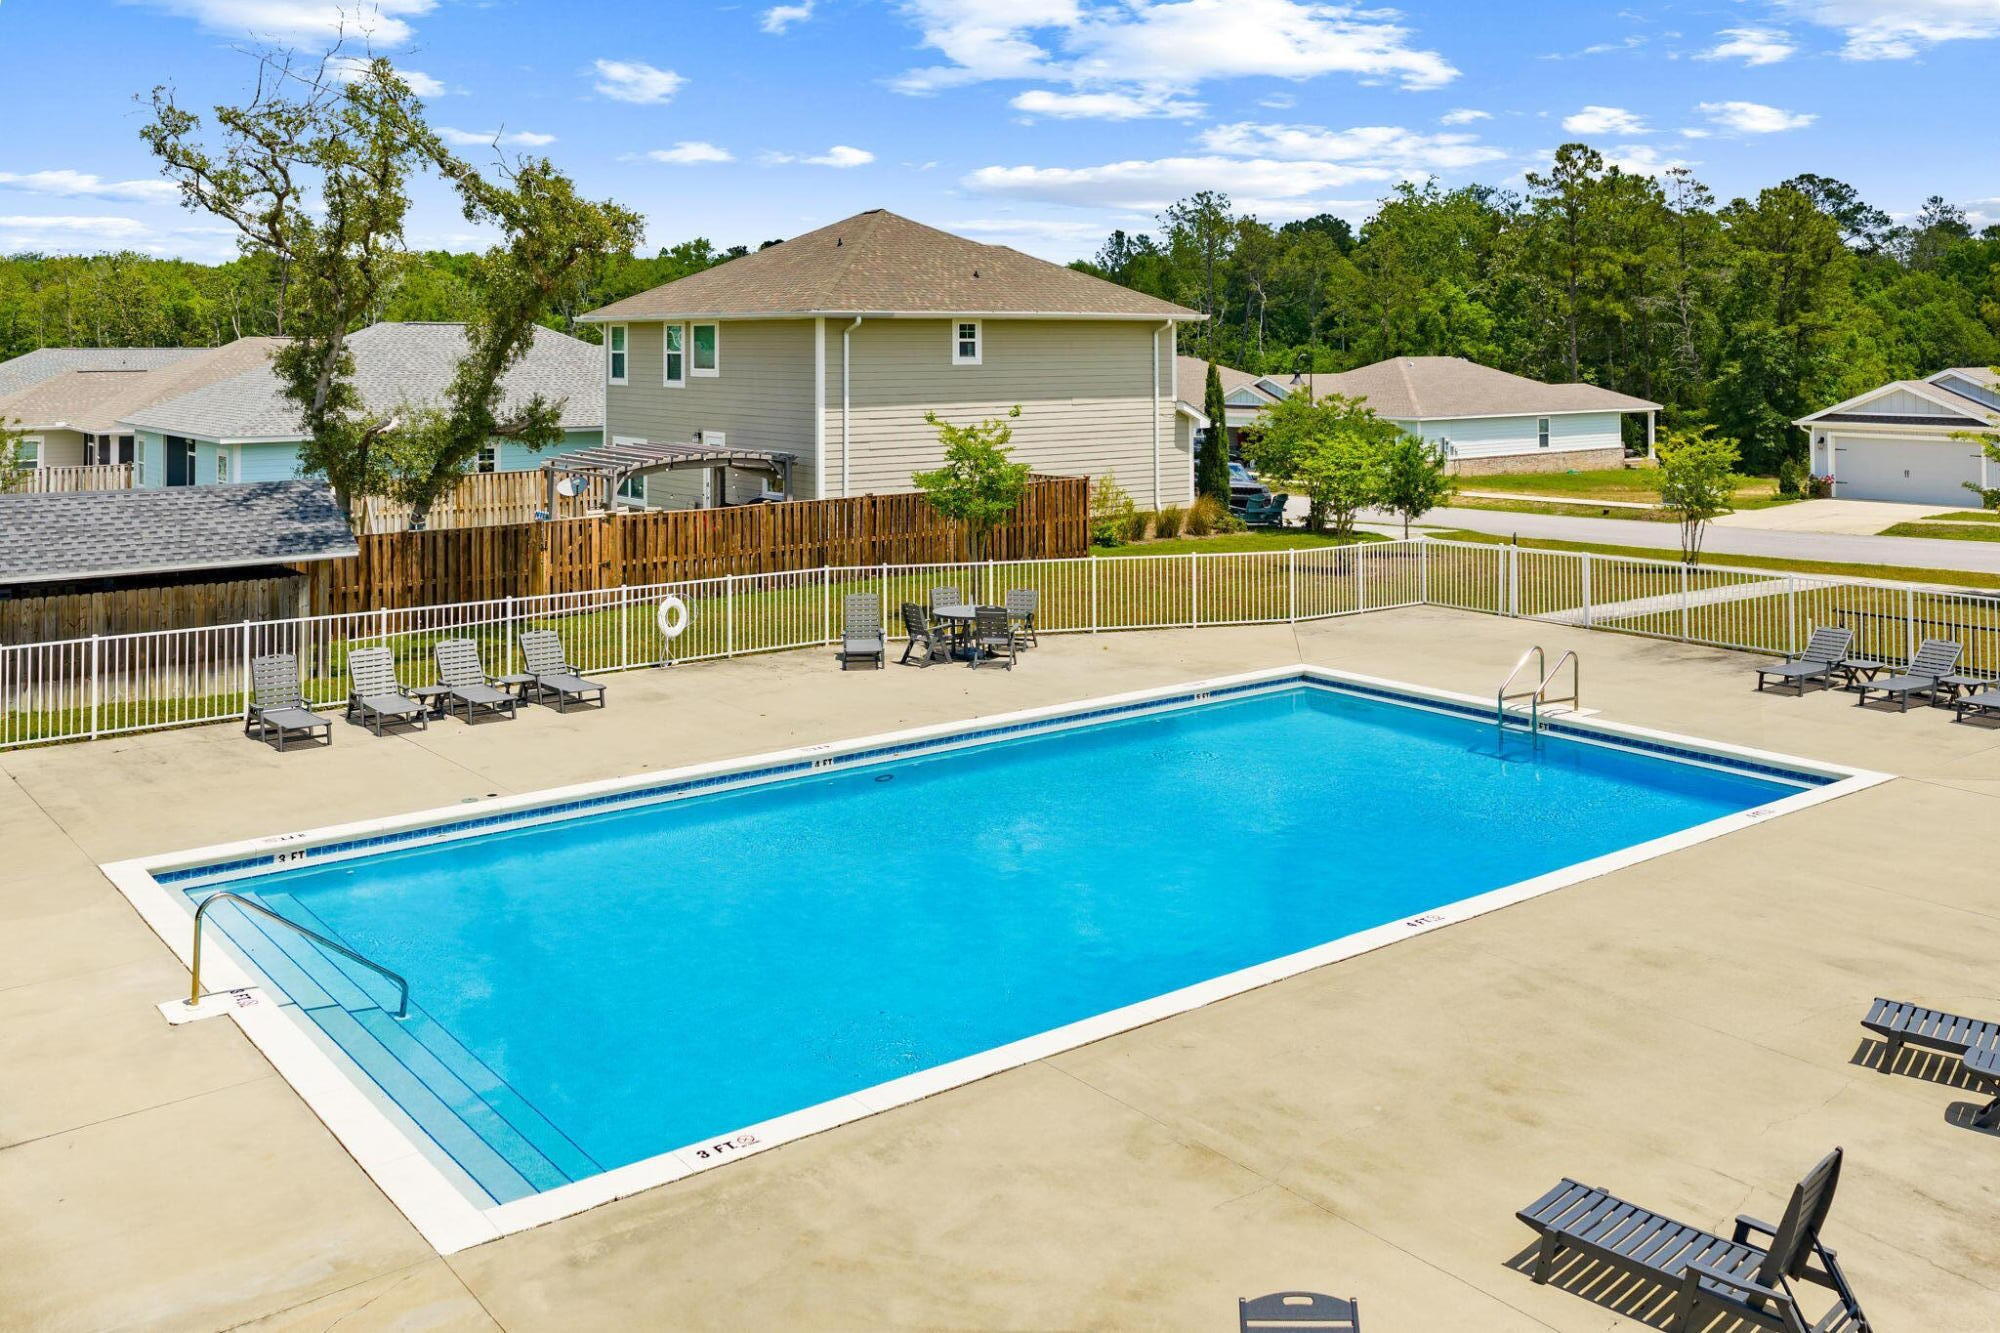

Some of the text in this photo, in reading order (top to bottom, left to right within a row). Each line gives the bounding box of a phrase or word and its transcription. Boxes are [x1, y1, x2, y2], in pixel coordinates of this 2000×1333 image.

[823, 758, 833, 766] FT
[278, 850, 305, 863] 3 FT
[696, 1150, 710, 1159] 3
[713, 1141, 735, 1153] FT
